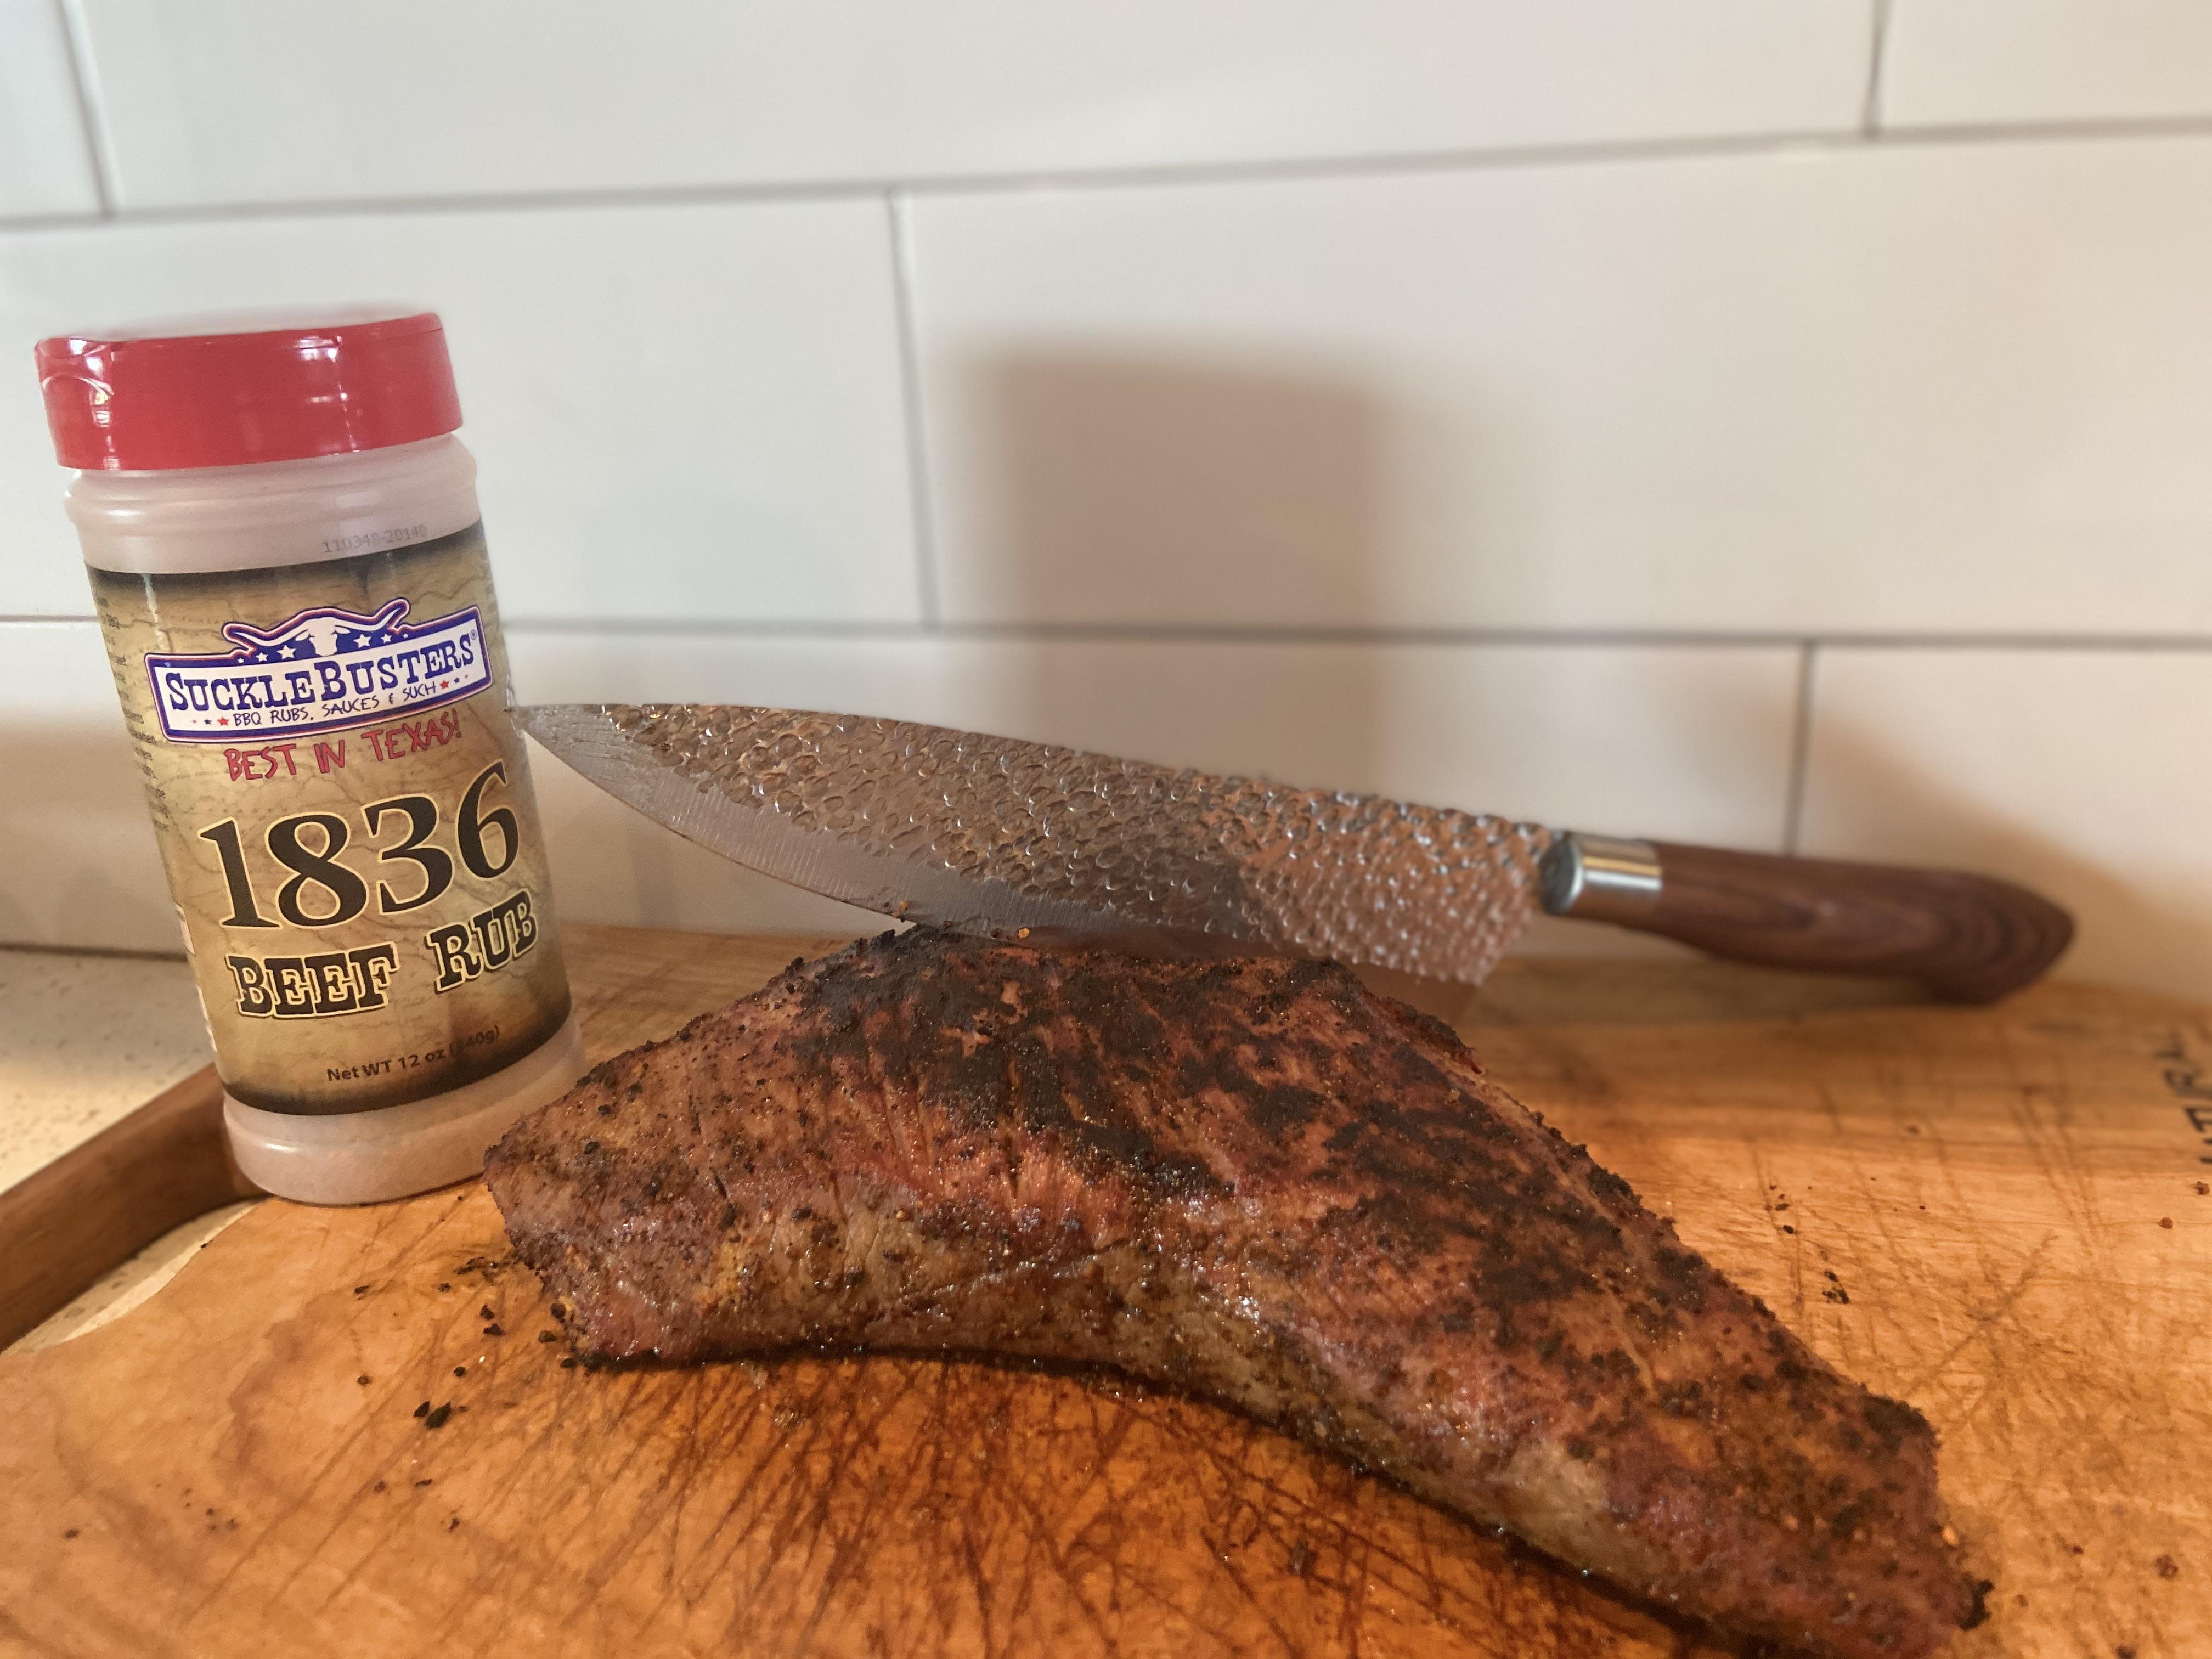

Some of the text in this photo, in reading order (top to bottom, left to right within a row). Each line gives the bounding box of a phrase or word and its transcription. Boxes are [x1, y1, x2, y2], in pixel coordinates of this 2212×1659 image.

[233, 712, 262, 726] BBQ
[321, 695, 379, 717] SAUCES
[403, 681, 436, 701] SUCH
[224, 708, 462, 781] BEST IN TEXAS!
[198, 761, 519, 929] 1836
[225, 888, 538, 1019] BEEF RUB
[327, 1066, 360, 1081] Net
[362, 1059, 391, 1077] WT
[398, 1054, 420, 1070] 12
[424, 1048, 445, 1063] oz
